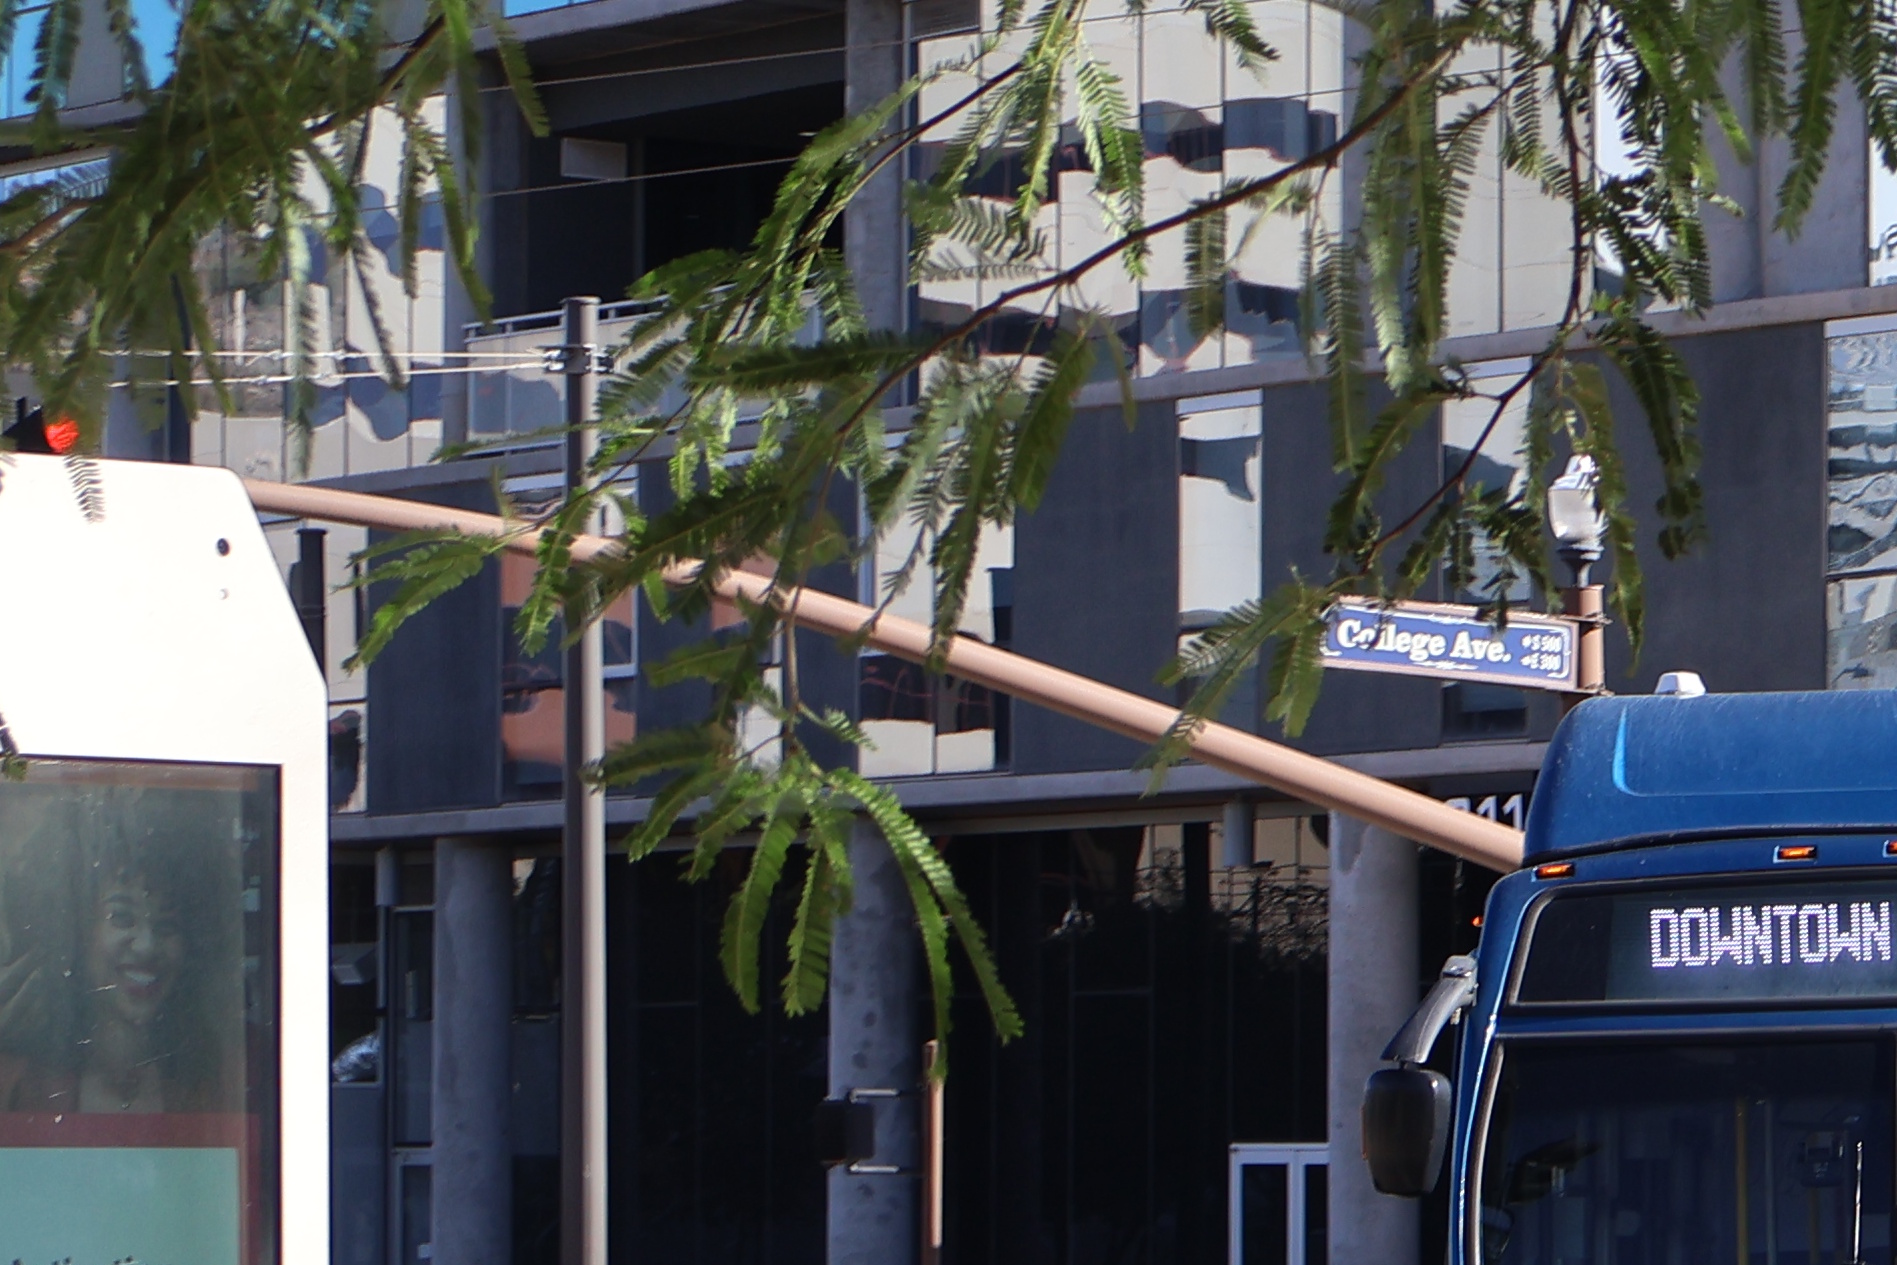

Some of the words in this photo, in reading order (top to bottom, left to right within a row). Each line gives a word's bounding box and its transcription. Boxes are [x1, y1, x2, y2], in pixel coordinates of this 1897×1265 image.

[1337, 618, 1446, 662] College
[1449, 630, 1512, 663] Ave.
[1650, 903, 1891, 968] DOWNTOWN
